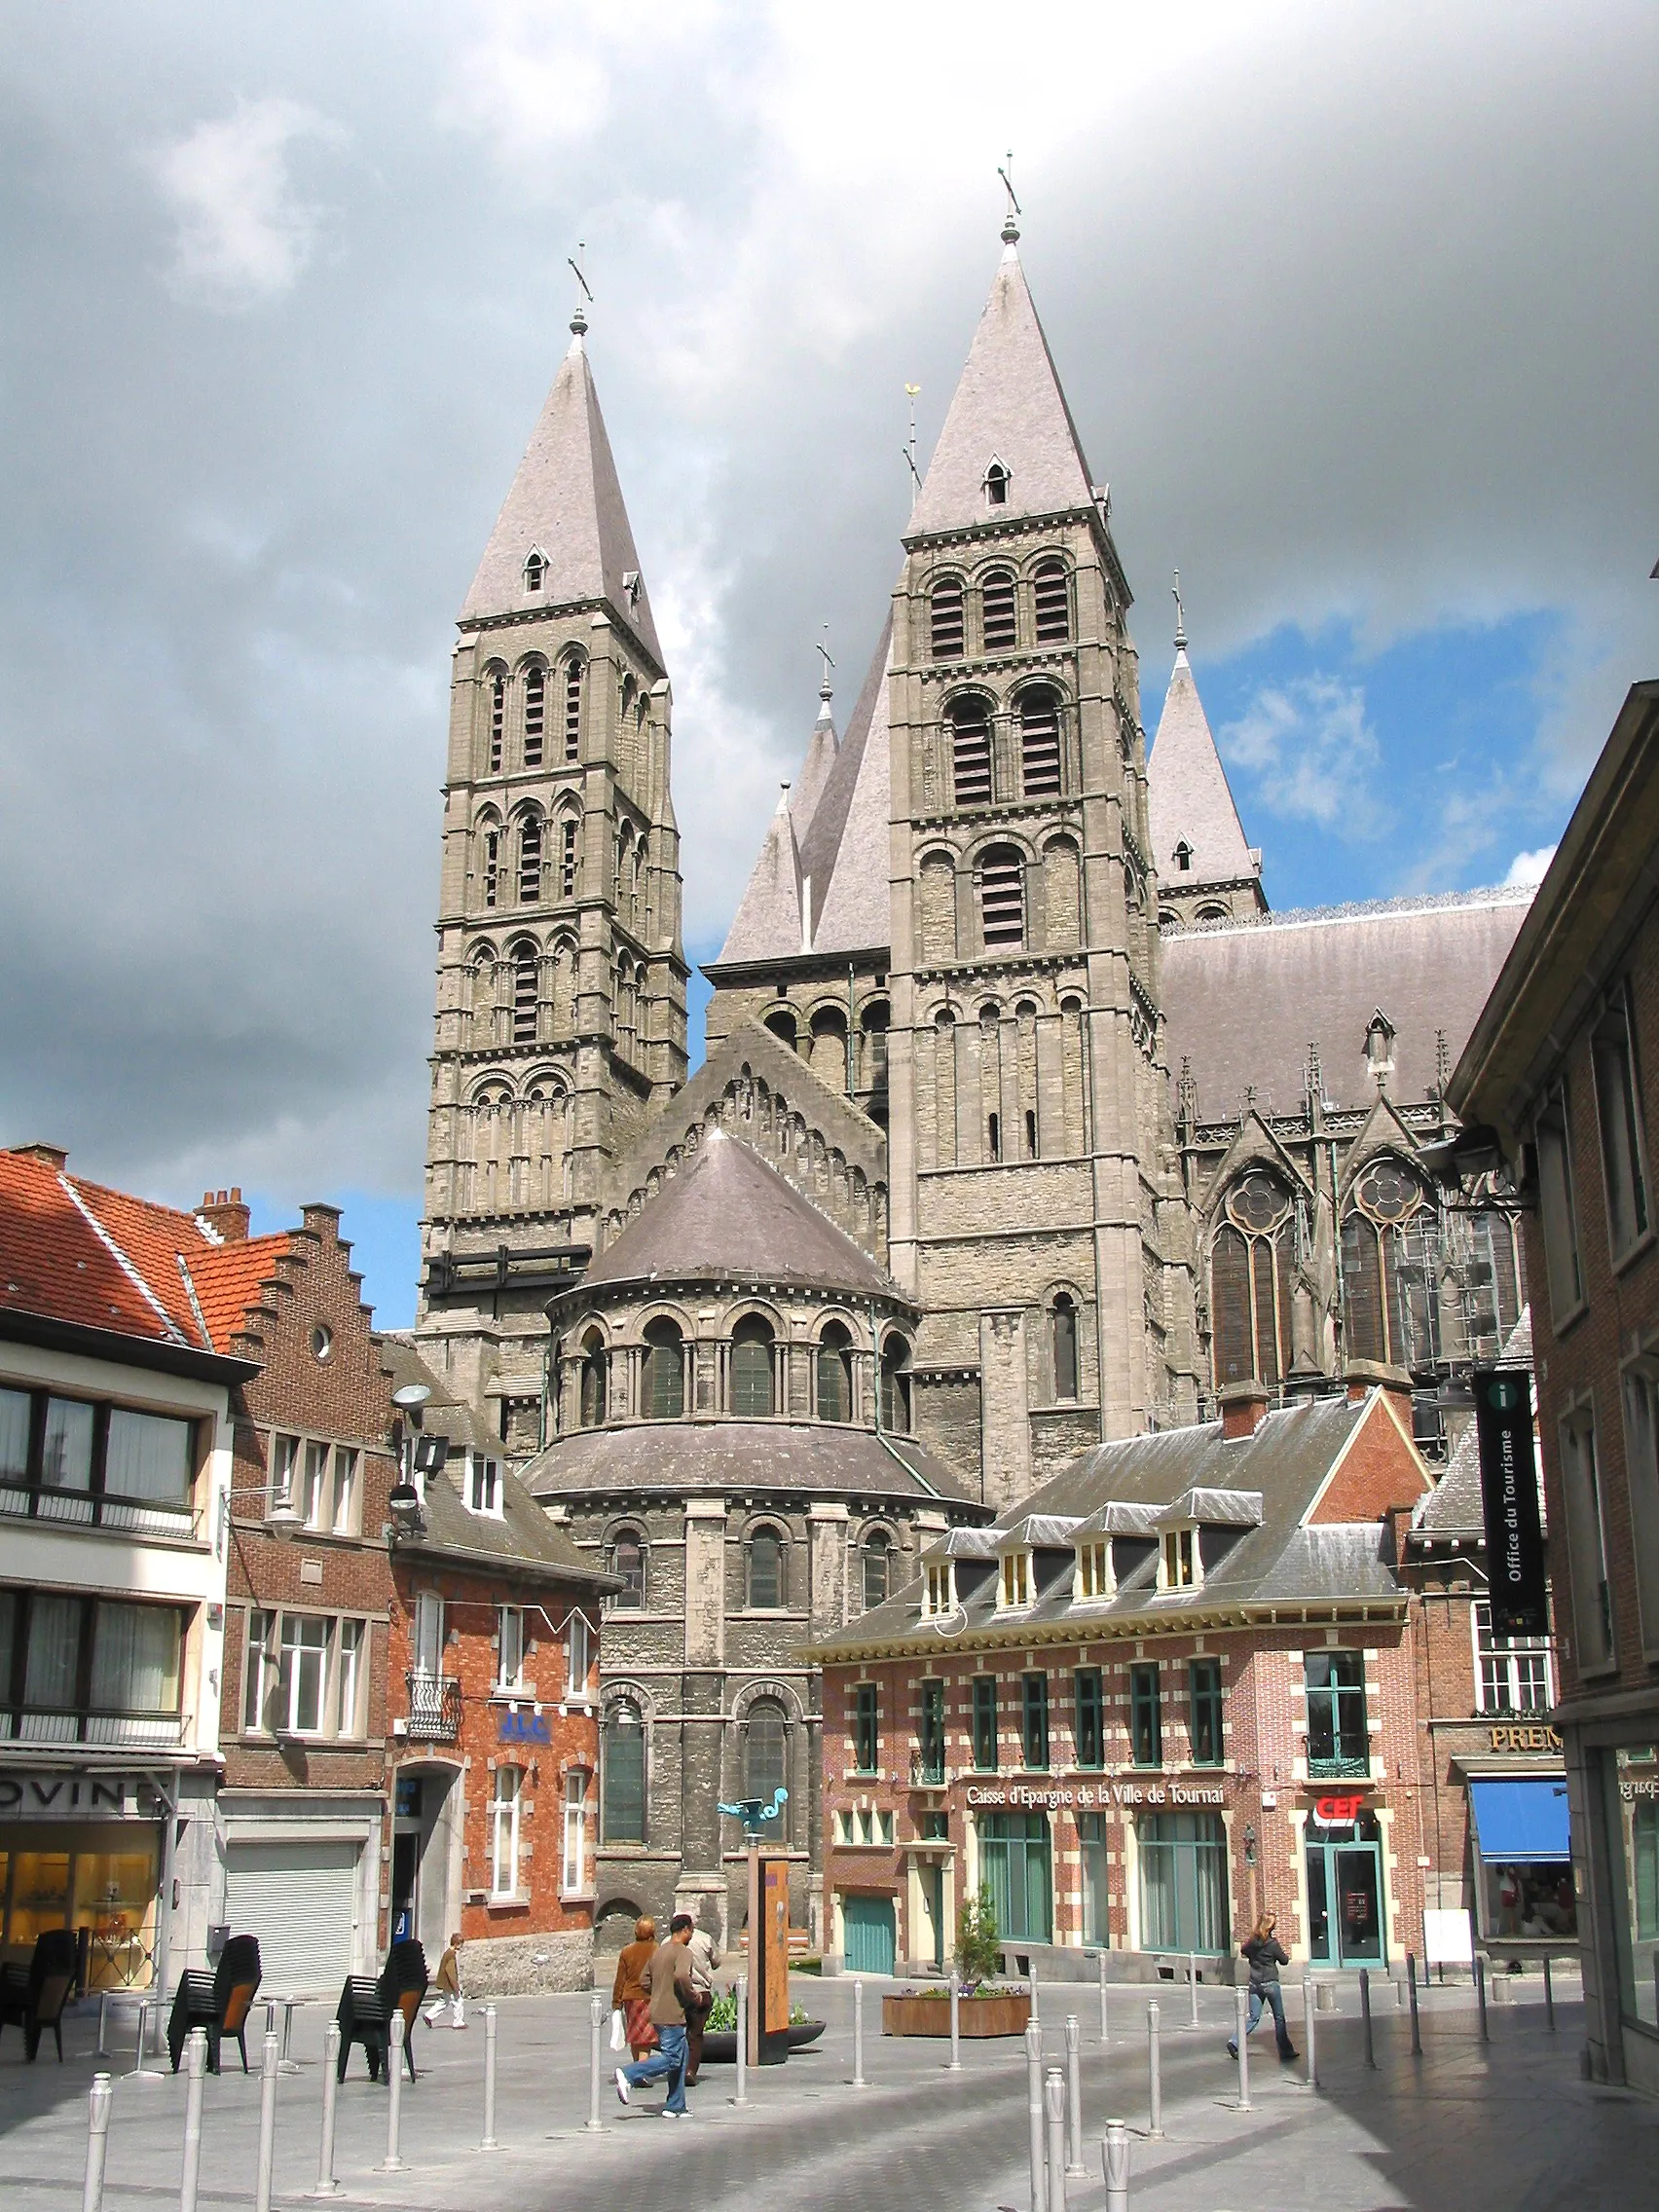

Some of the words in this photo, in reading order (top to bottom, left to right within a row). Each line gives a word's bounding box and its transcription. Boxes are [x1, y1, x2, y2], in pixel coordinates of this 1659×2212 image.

[1499, 1429, 1516, 1504] Tourisme
[1504, 1508, 1518, 1529] du
[1506, 1532, 1522, 1583] Office
[967, 1786, 1006, 1804] Caisse
[1009, 1786, 1073, 1809] d'Epargne
[1077, 1785, 1094, 1804] de
[1098, 1784, 1110, 1803] la
[1112, 1784, 1143, 1804] Ville
[1147, 1784, 1165, 1804] de
[1168, 1784, 1224, 1804] Tournai
[1316, 1795, 1364, 1819] CET
